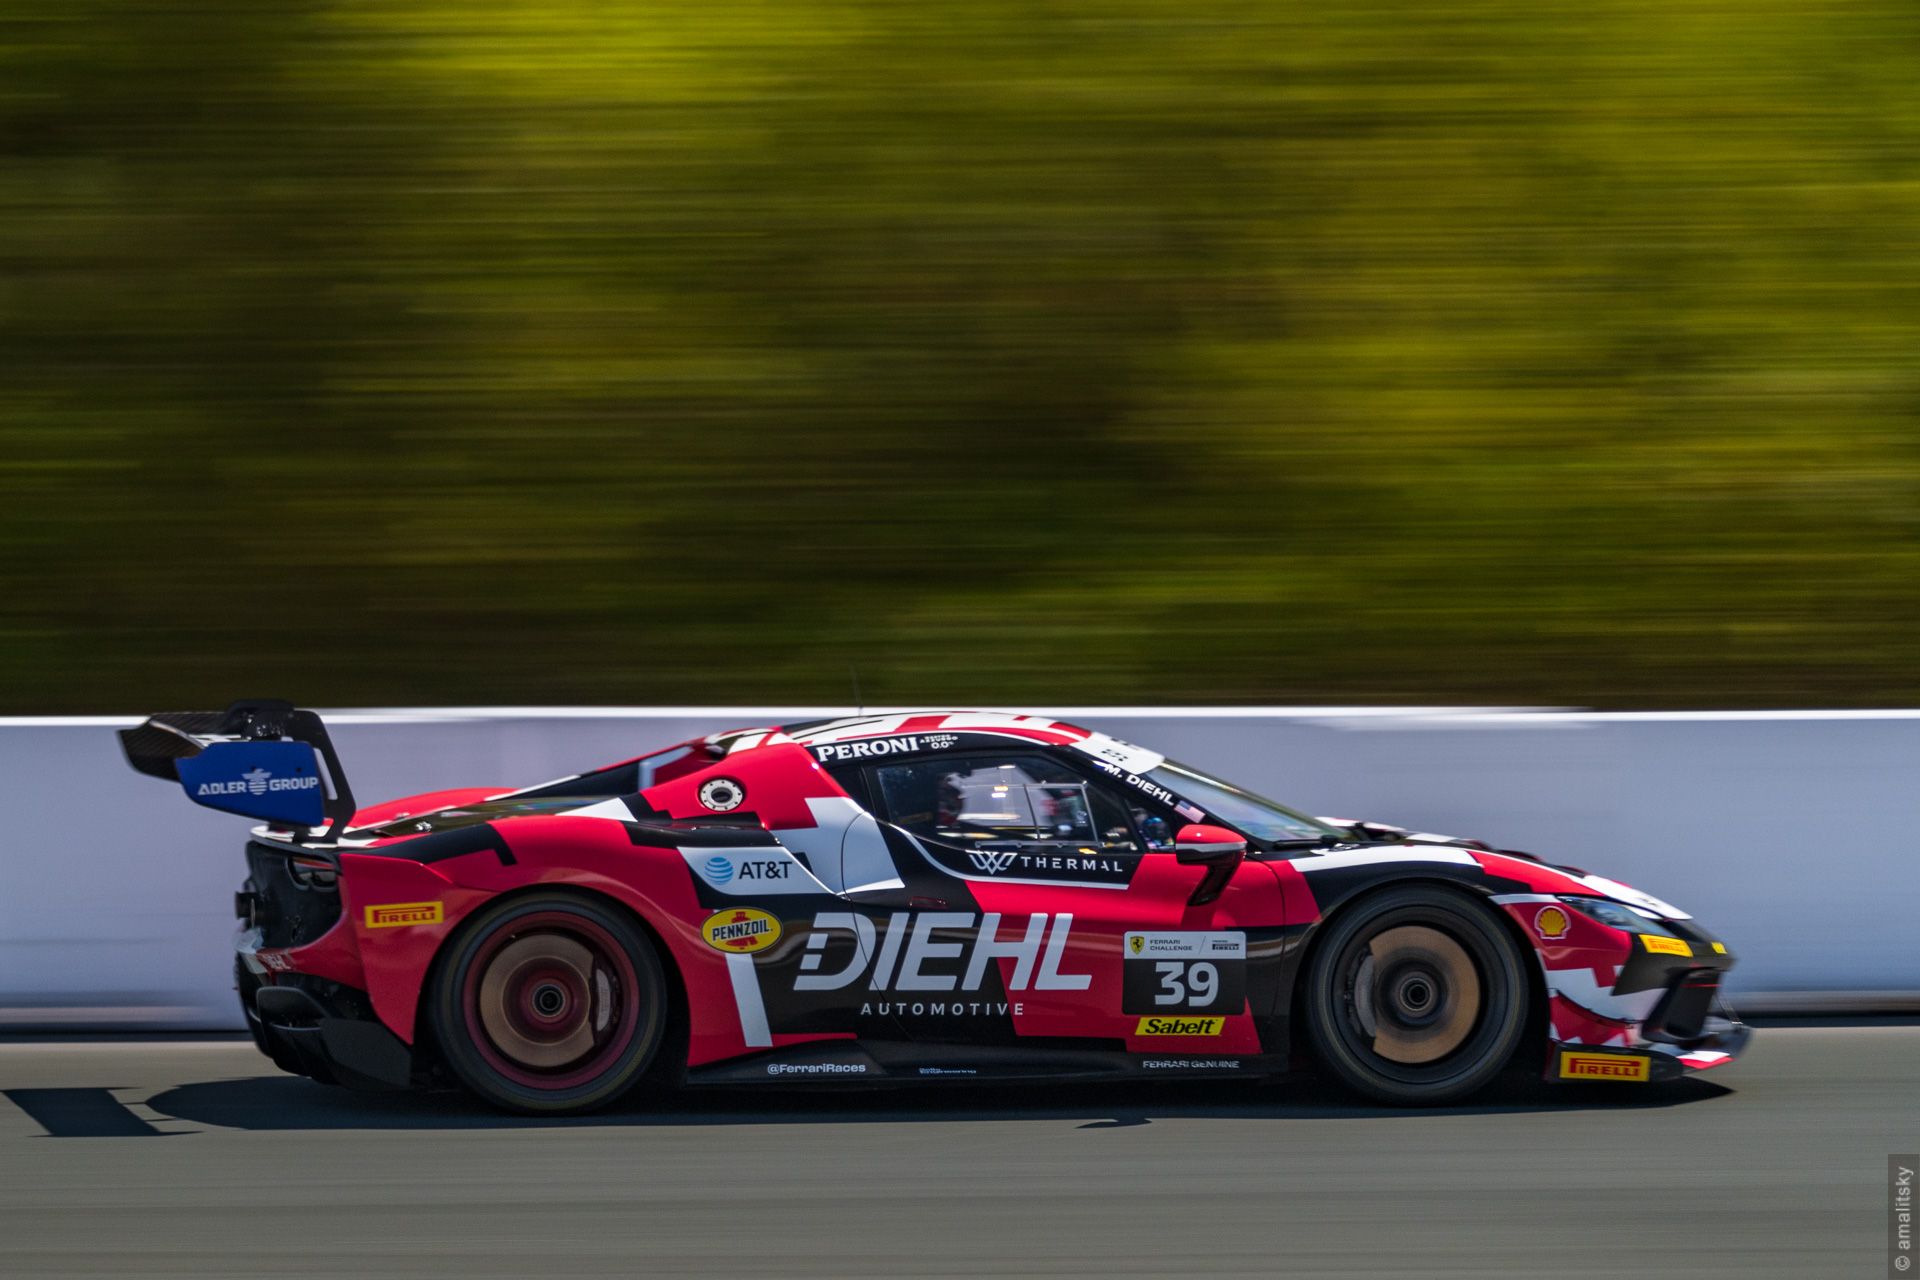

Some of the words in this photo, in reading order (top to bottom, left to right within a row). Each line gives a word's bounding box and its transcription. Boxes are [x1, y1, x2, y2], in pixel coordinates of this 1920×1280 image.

[815, 736, 920, 762] PERONI
[198, 781, 247, 795] ADLER
[269, 777, 319, 791] GROUP
[1102, 763, 1123, 778] M.
[1126, 774, 1175, 806] DIEHL
[738, 861, 793, 880] AT&T
[1021, 856, 1123, 872] THERMAL
[373, 906, 436, 924] PIRELLI
[712, 918, 773, 942] PENNZOIL
[793, 912, 1093, 991] DIEHL
[1154, 961, 1219, 1007] 39
[860, 1002, 1025, 1016] AUTOMOTIVE
[1145, 1018, 1216, 1035] Sabelt
[767, 1063, 866, 1075] @FerrariRaces
[1569, 1057, 1642, 1077] PIRELLI
